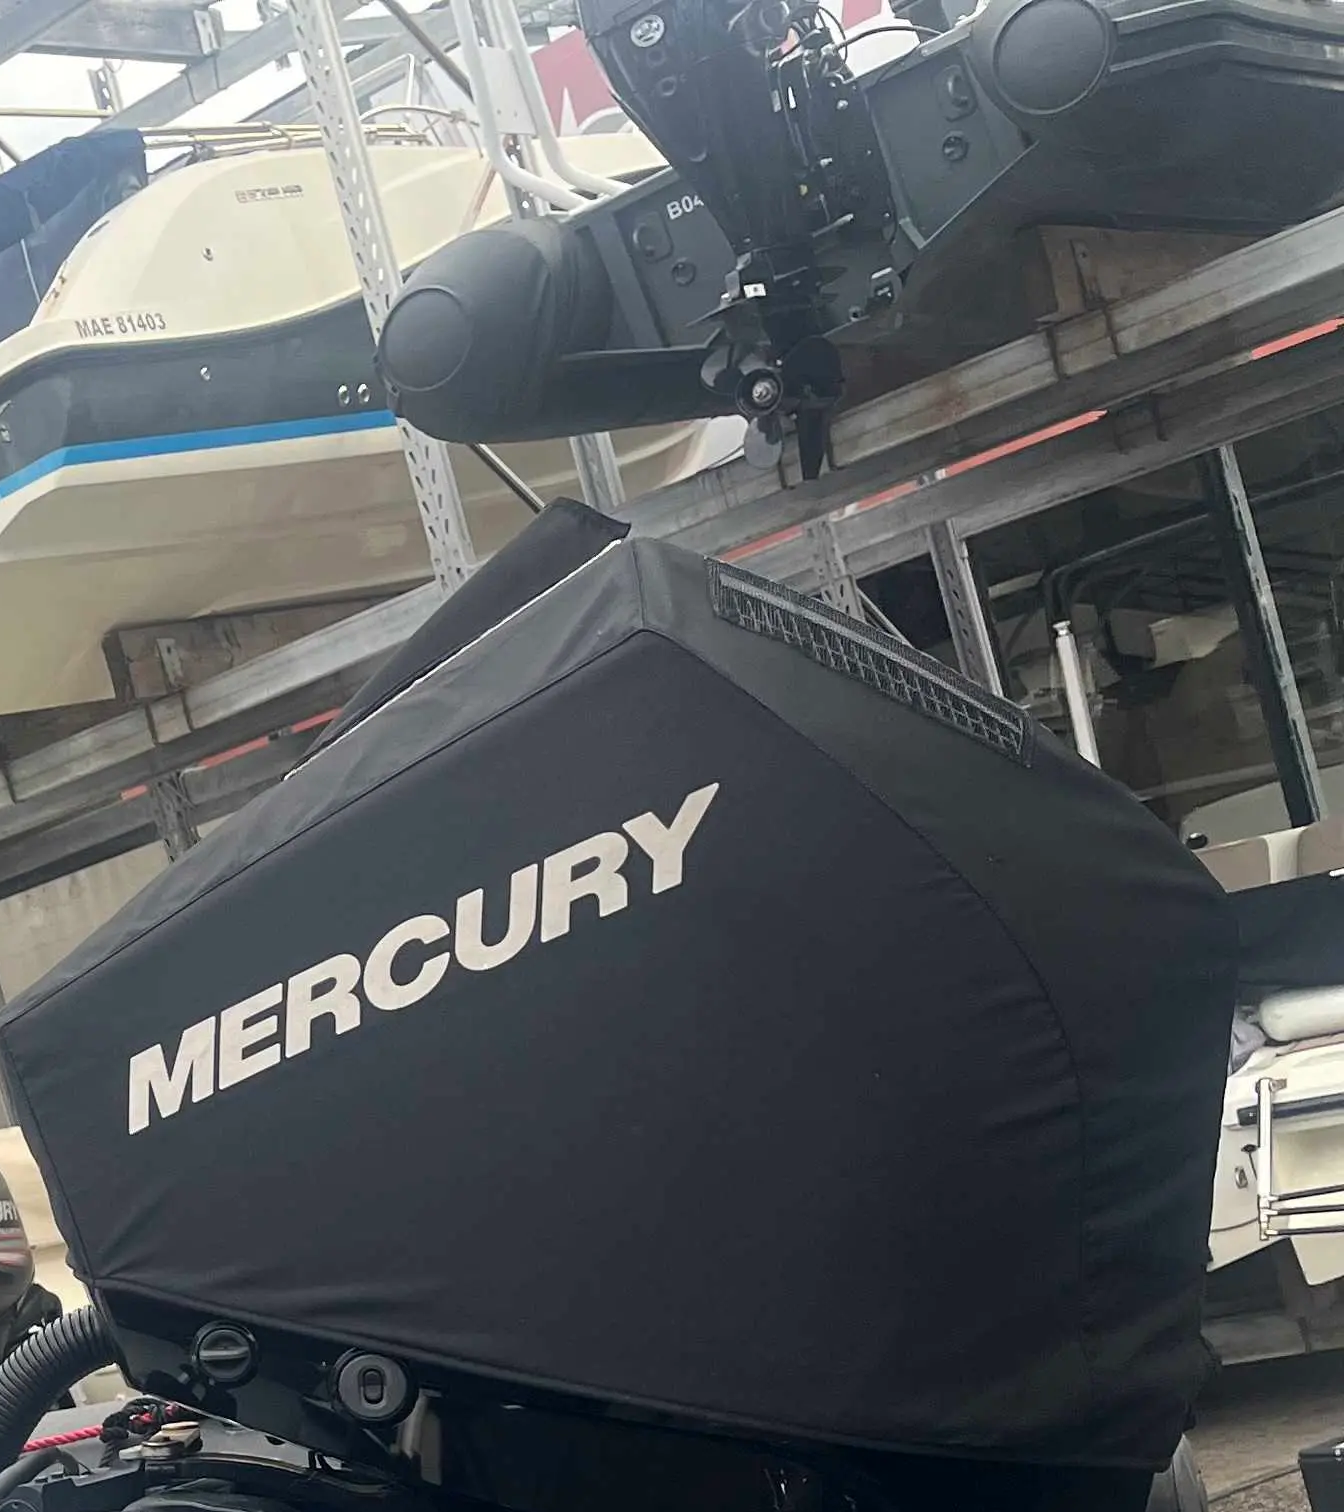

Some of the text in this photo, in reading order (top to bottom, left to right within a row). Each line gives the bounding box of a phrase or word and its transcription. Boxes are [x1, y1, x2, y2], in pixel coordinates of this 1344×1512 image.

[74, 312, 167, 339] MAE 81403
[128, 782, 720, 1136] MERCURY
